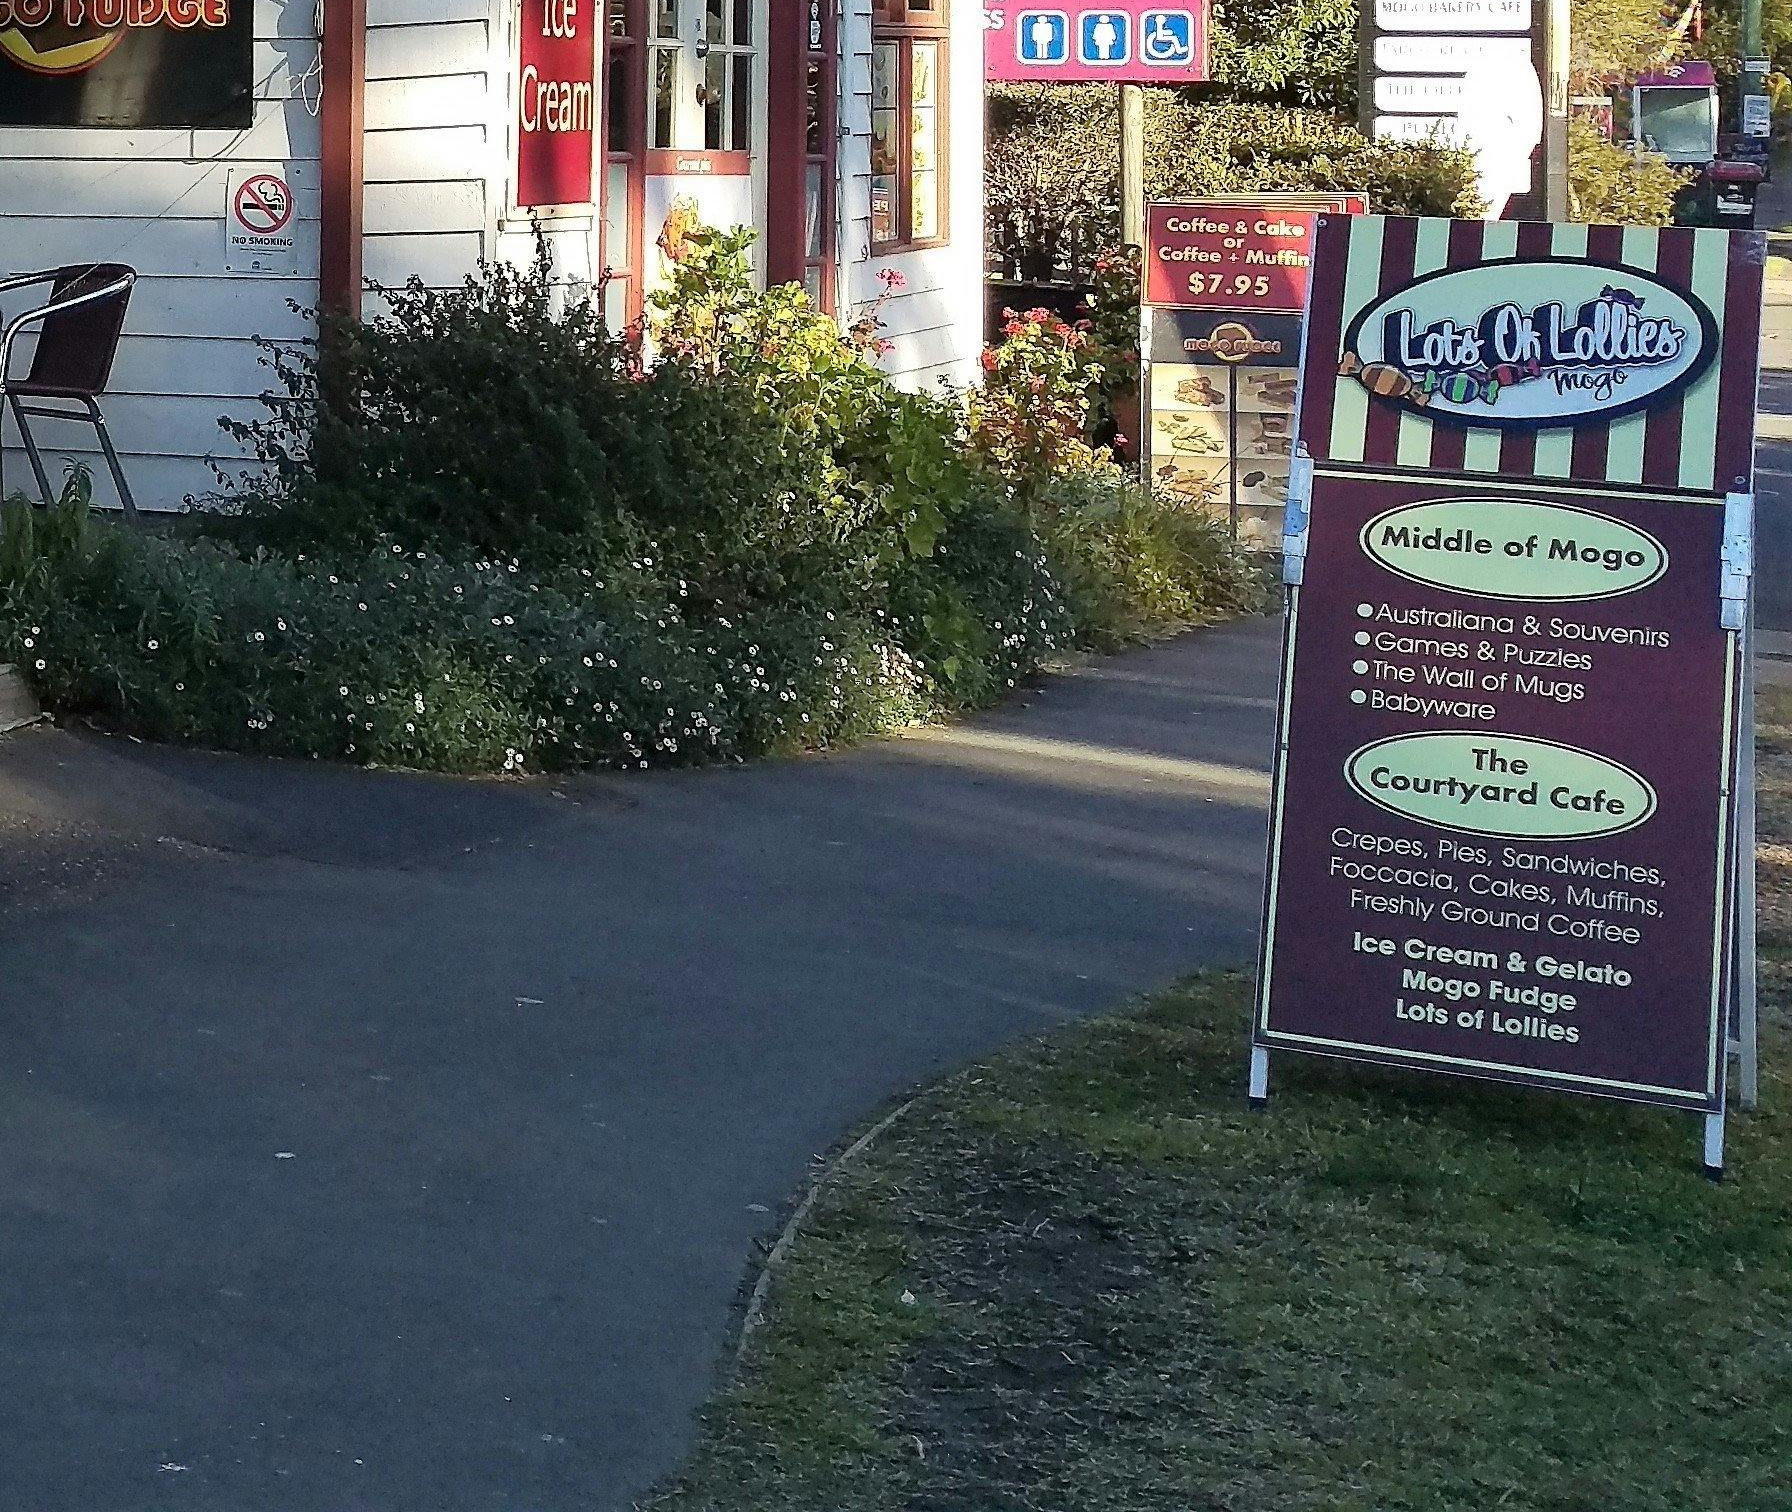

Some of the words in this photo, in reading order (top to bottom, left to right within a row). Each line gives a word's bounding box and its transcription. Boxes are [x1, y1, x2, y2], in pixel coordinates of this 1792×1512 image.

[520, 64, 593, 133] Cream
[231, 236, 247, 245] NO
[248, 236, 294, 247] SMOKING
[1166, 217, 1230, 235] Coffee
[1234, 220, 1248, 235] &
[1253, 220, 1306, 237] Cake
[1223, 237, 1245, 249] or
[1158, 246, 1222, 263] Coffee
[1245, 249, 1311, 267] Muffin
[1188, 271, 1270, 296] $7.95
[1390, 306, 1485, 368] Lots
[1548, 296, 1686, 362] Lollies
[1381, 525, 1493, 555] Middle
[1503, 534, 1538, 559] of
[1547, 538, 1646, 571] Mogo
[1374, 602, 1514, 635] Australiana
[1523, 614, 1542, 636] &
[1549, 616, 1671, 648] Souvenirs
[1374, 632, 1469, 660] Games
[1477, 641, 1496, 663] &
[1504, 645, 1593, 671] Puzzles
[1373, 659, 1416, 683] The
[1421, 663, 1475, 689] Wall
[1481, 668, 1508, 692] of
[1514, 673, 1585, 703] Mugs
[1371, 689, 1497, 721] Babyware
[1471, 747, 1529, 775] The
[1370, 766, 1538, 805] Courtyard
[1550, 787, 1626, 816] Cafe
[1330, 826, 1429, 861] Crepes,
[1437, 839, 1494, 867] Pies,
[1501, 846, 1668, 888] Sandwiches,
[1329, 855, 1459, 894] Foccacia,
[1468, 873, 1558, 906] Cakes,
[1566, 884, 1665, 920] Muffins,
[1350, 889, 1434, 922] Freshly
[1441, 900, 1539, 932] Ground
[1547, 914, 1642, 946] Coffee
[1352, 930, 1397, 956] Ice
[1404, 937, 1498, 970] Cream
[1506, 951, 1528, 974] &
[1535, 954, 1633, 988] Gelato
[1401, 968, 1481, 1003] Mogo
[1489, 981, 1578, 1014] Fudge
[1395, 998, 1451, 1025] Lots
[1456, 1008, 1485, 1030] of
[1492, 1015, 1581, 1045] Lollies
